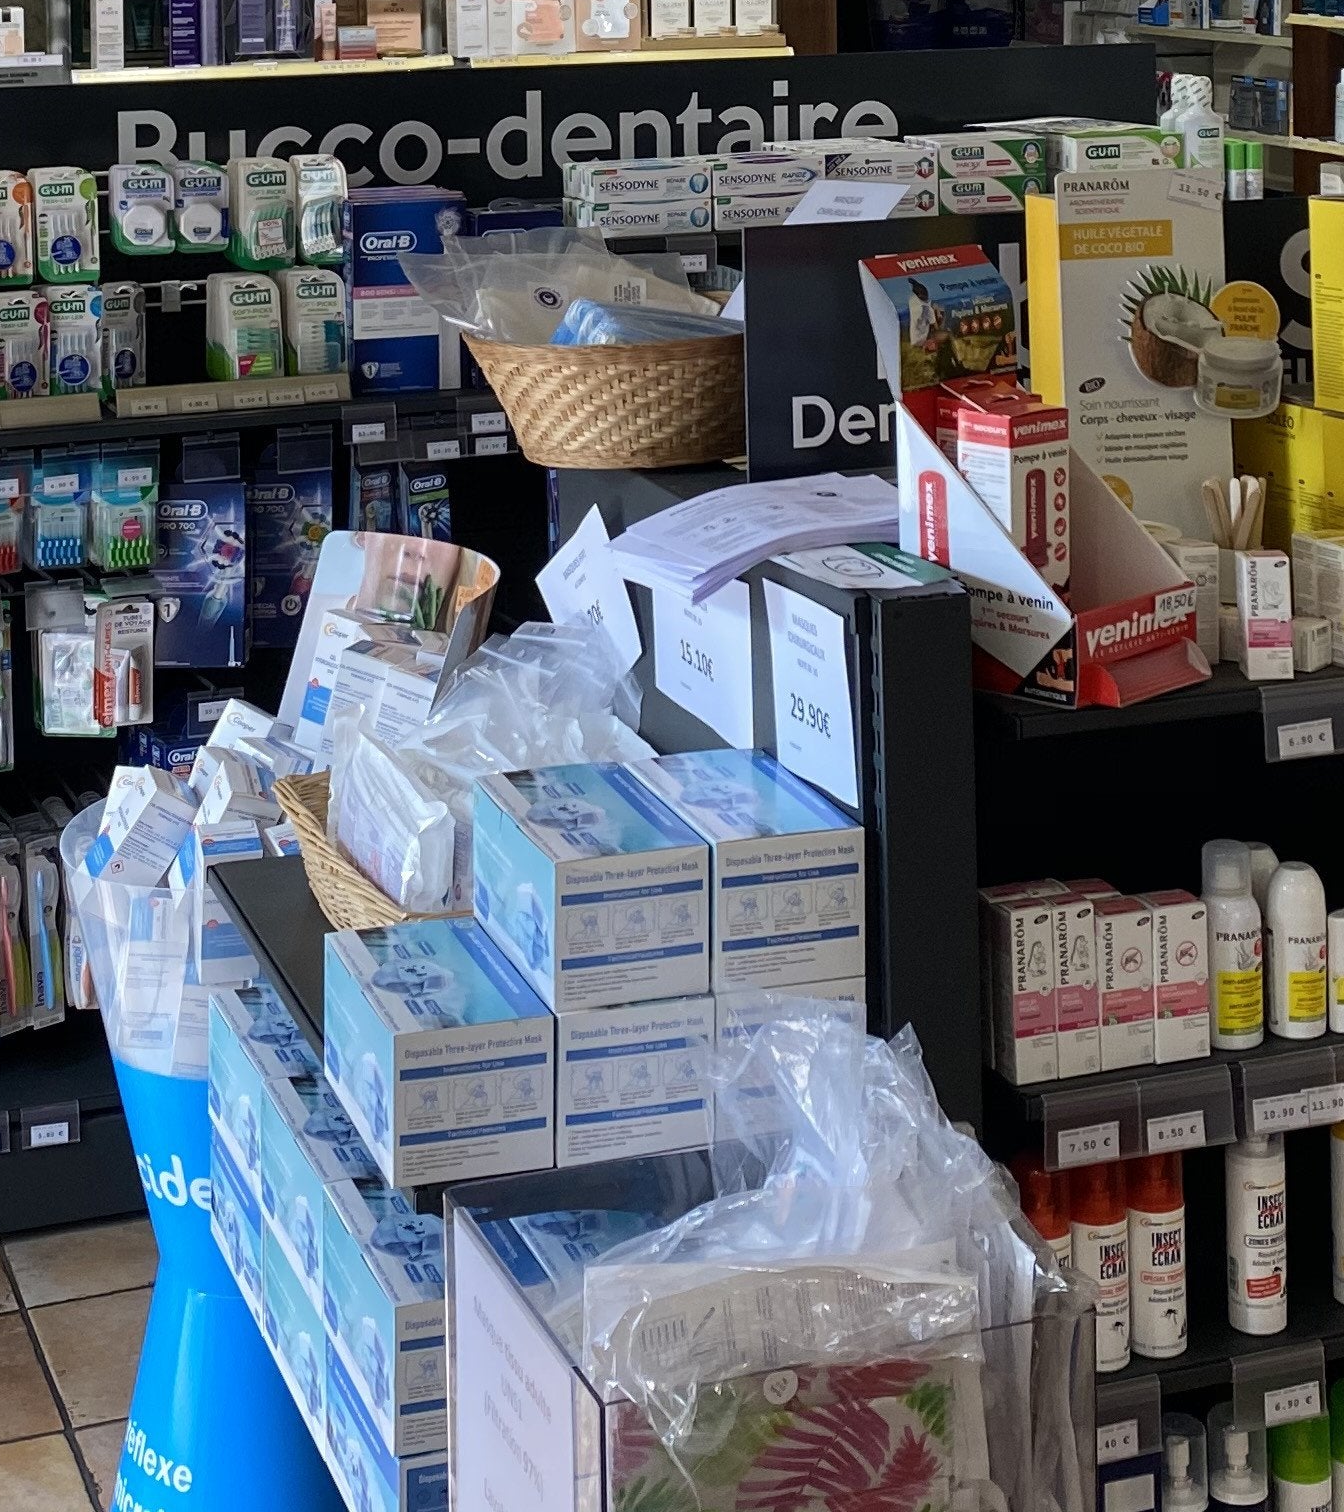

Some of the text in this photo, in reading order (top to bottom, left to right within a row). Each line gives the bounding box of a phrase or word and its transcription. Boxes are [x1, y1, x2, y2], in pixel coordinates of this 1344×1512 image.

[1088, 145, 1119, 158] GUM
[599, 179, 659, 192] SENSODYNE
[719, 173, 777, 185] SENSODYNE
[1063, 179, 1130, 193] PRANARÔM
[600, 214, 660, 227] SENSODYNE
[722, 207, 781, 220] SENSODYNE
[1073, 227, 1106, 239] HUILE
[364, 235, 413, 250] Oral-B
[1092, 242, 1124, 255] COCO
[897, 252, 960, 272] venimex
[1079, 409, 1197, 426] Corps cheveux visage
[1013, 417, 1067, 438] venimex
[1013, 452, 1040, 465] Pompe
[413, 476, 443, 490] Oral-B
[159, 503, 203, 518] Oral-B
[923, 480, 937, 562] venimex
[1019, 595, 1055, 612] venin
[679, 638, 716, 683] 15.10€
[789, 691, 832, 740] 29.90€
[837, 845, 856, 856] Mask
[681, 862, 700, 872] Mask
[1013, 916, 1028, 992] PRANARÔM
[1056, 910, 1070, 986] PRANARÔM
[1104, 921, 1116, 990] PRANARÔM
[523, 1035, 544, 1046] Mask
[1311, 1096, 1344, 1112] 11.90
[1262, 1106, 1296, 1122] 10.90
[1069, 1138, 1097, 1153] 7.50
[1151, 1227, 1183, 1249] INSECT
[1151, 1249, 1182, 1268] ECRAN
[404, 1315, 444, 1331] Disposable
